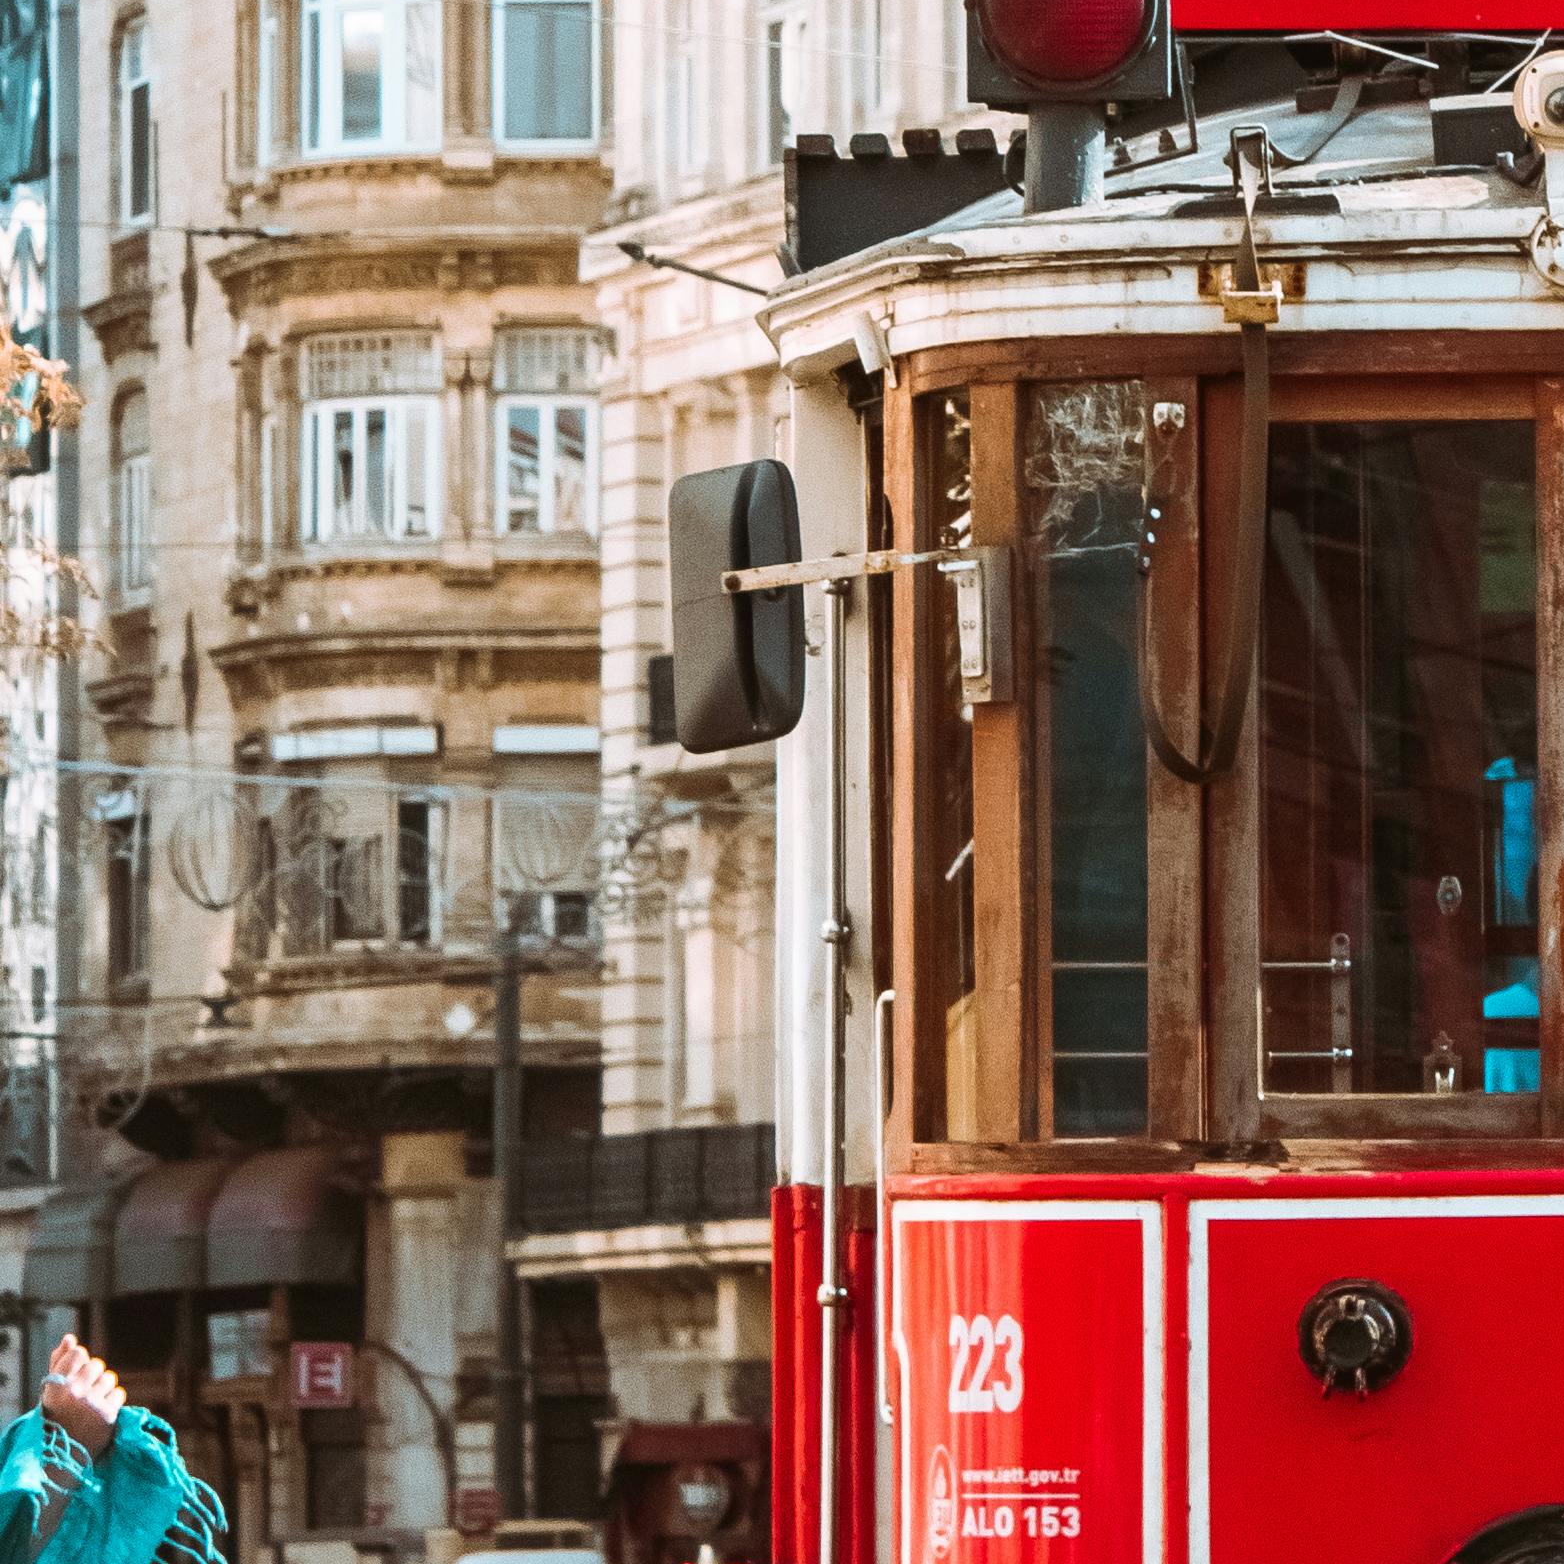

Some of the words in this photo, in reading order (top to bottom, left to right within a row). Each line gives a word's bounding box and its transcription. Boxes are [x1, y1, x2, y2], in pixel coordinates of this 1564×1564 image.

[948, 1314, 1024, 1413] 223
[962, 1506, 1014, 1537] ALO
[1023, 1506, 1081, 1538] 153
